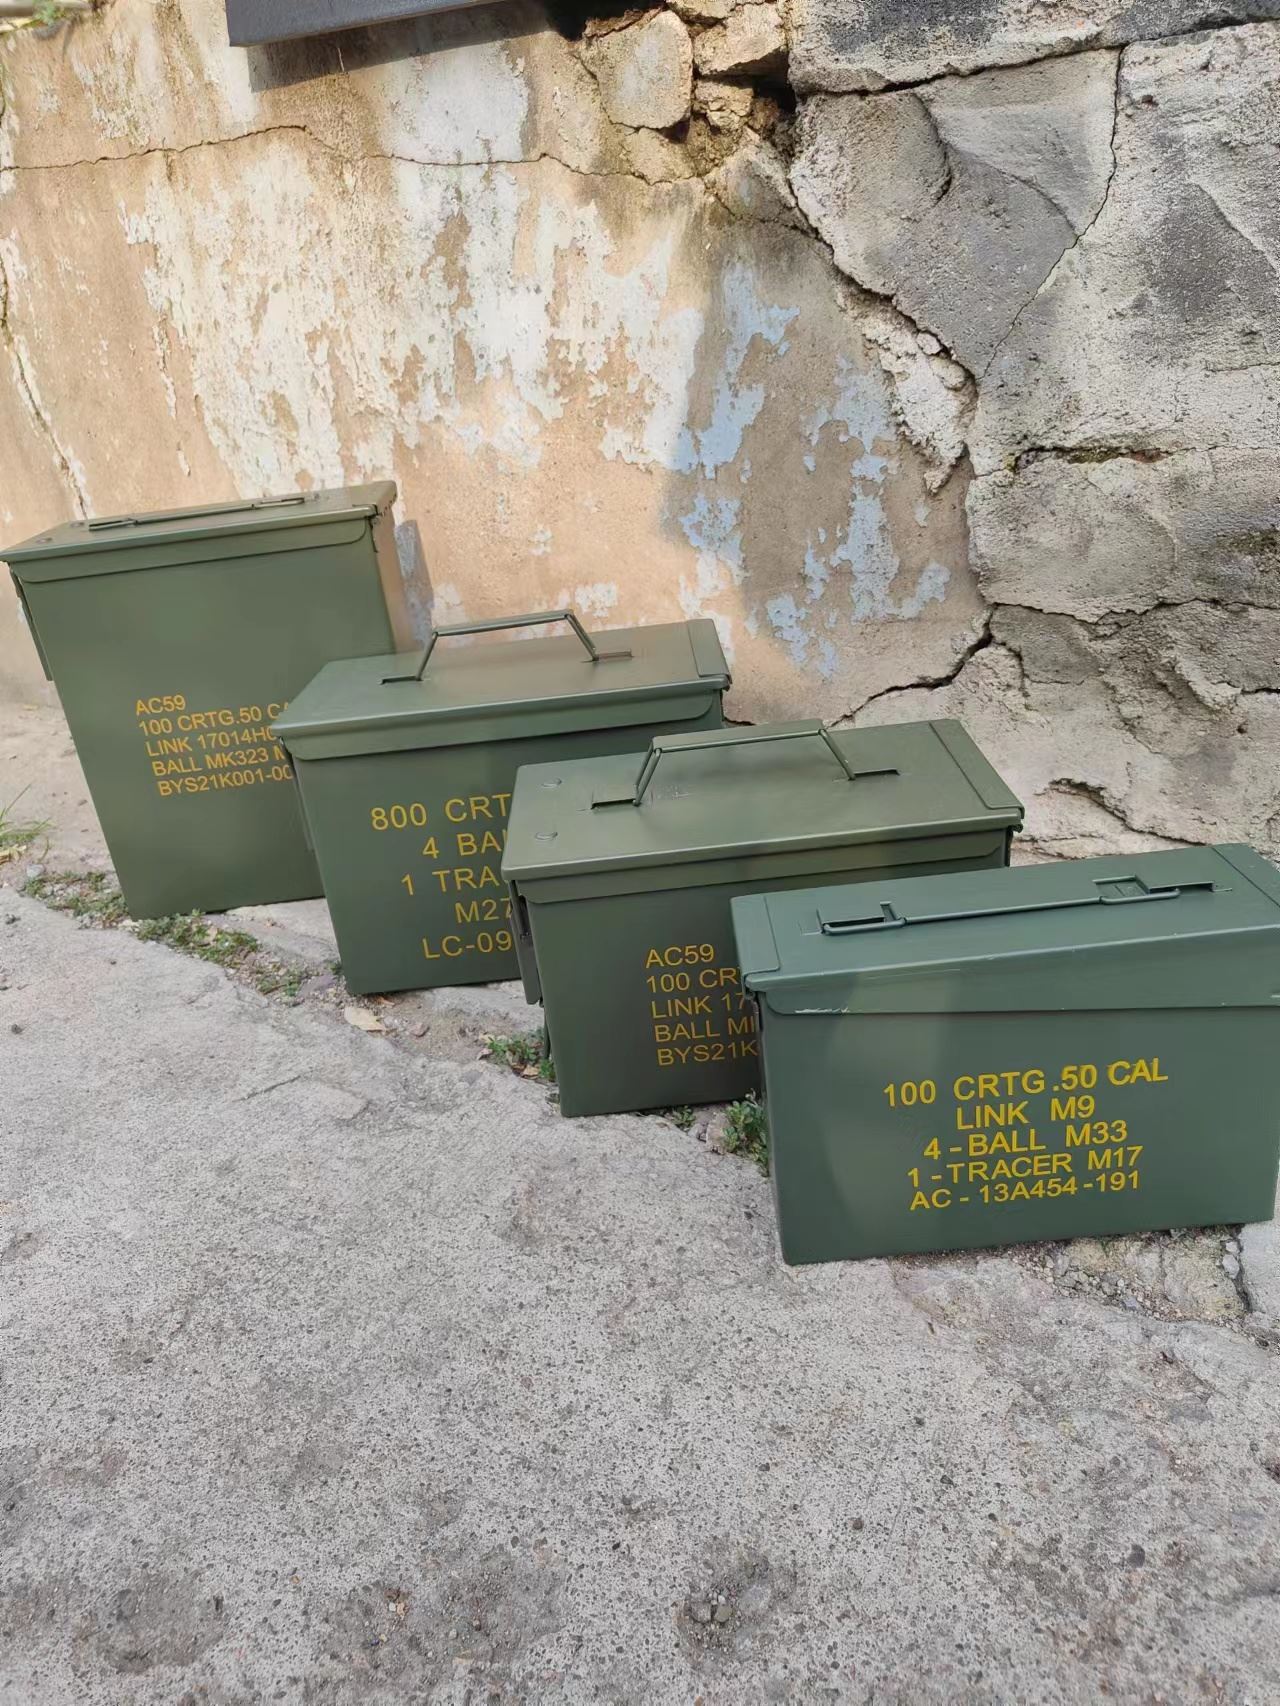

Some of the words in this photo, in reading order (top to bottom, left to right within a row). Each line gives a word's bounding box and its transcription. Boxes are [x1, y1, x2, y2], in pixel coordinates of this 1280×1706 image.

[136, 694, 186, 716] AC59
[139, 718, 172, 736] 100
[146, 737, 192, 756] LINK
[152, 757, 202, 776] BALL
[205, 747, 268, 771] MK323
[370, 803, 426, 830] 800
[445, 794, 511, 822] CRT
[422, 836, 440, 858] 4
[402, 874, 414, 896] 1
[422, 930, 512, 958] LC-09
[646, 944, 714, 968] AC59
[646, 972, 690, 993] 100
[652, 996, 712, 1019] LINK
[654, 1020, 720, 1042] BALL
[883, 1080, 936, 1107] 100
[1107, 1058, 1168, 1086] CAL
[956, 1100, 1030, 1130] LINK
[1050, 1095, 1095, 1121] M9
[1066, 1120, 1128, 1147] M33
[1088, 1146, 1144, 1170] M17
